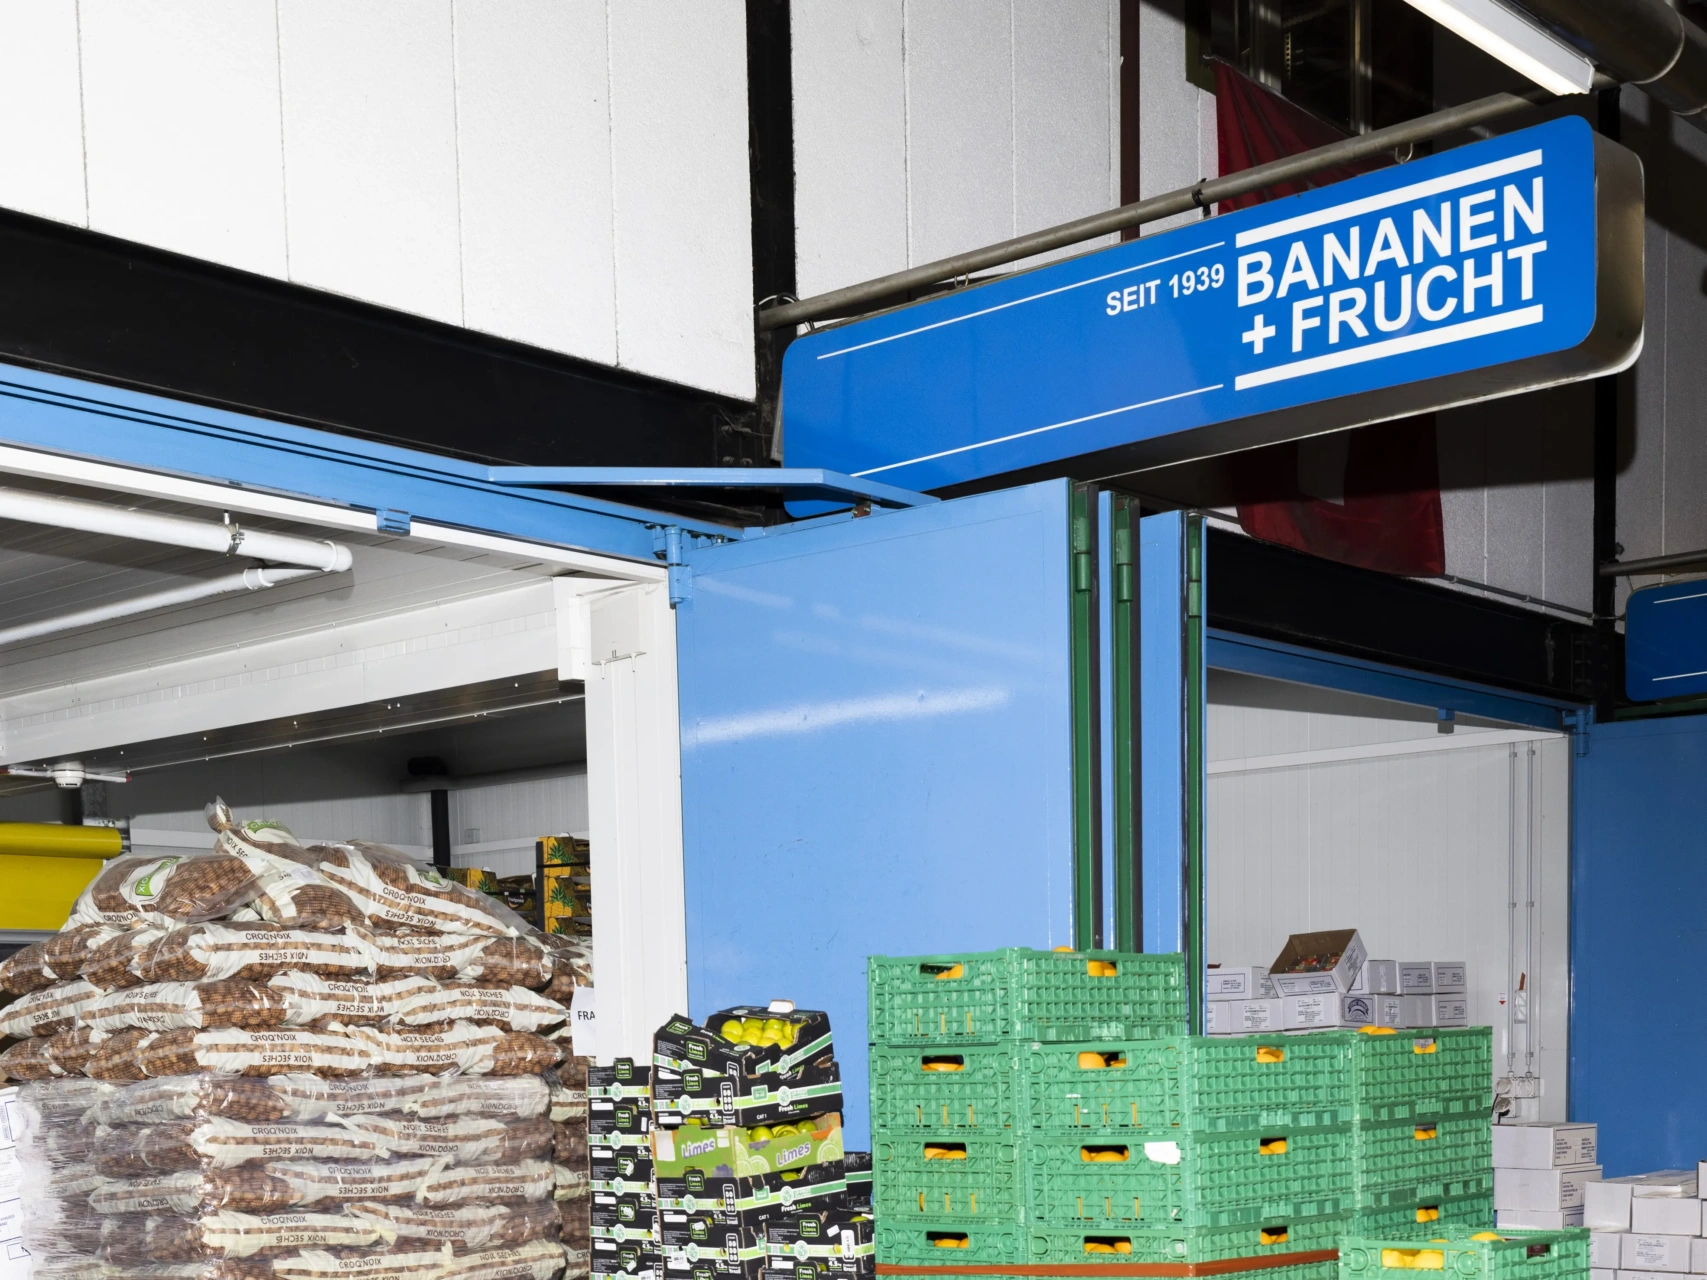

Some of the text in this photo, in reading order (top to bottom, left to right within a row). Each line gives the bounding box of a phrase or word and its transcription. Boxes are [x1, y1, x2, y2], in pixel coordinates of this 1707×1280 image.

[1237, 176, 1544, 307] BANANEN
[1106, 264, 1225, 317] SEIT 1939
[1242, 241, 1548, 354] + FRUCHT
[385, 909, 436, 927] NOIX SECHES
[713, 1035, 725, 1043] Limes
[688, 1043, 703, 1051] Fresh
[262, 1055, 313, 1063] NOIX SECHES
[336, 1102, 385, 1112] NOIX SECHES
[252, 1128, 298, 1136] CROQ'NOIX
[263, 1147, 291, 1155] SECHES
[682, 1138, 715, 1159] Limes
[777, 1142, 810, 1166] Limes
[370, 1186, 389, 1194] NOIX
[781, 1204, 796, 1212] Fresh
[276, 1235, 304, 1243] SECHES
[339, 1259, 382, 1268] CROQ'NOIX
